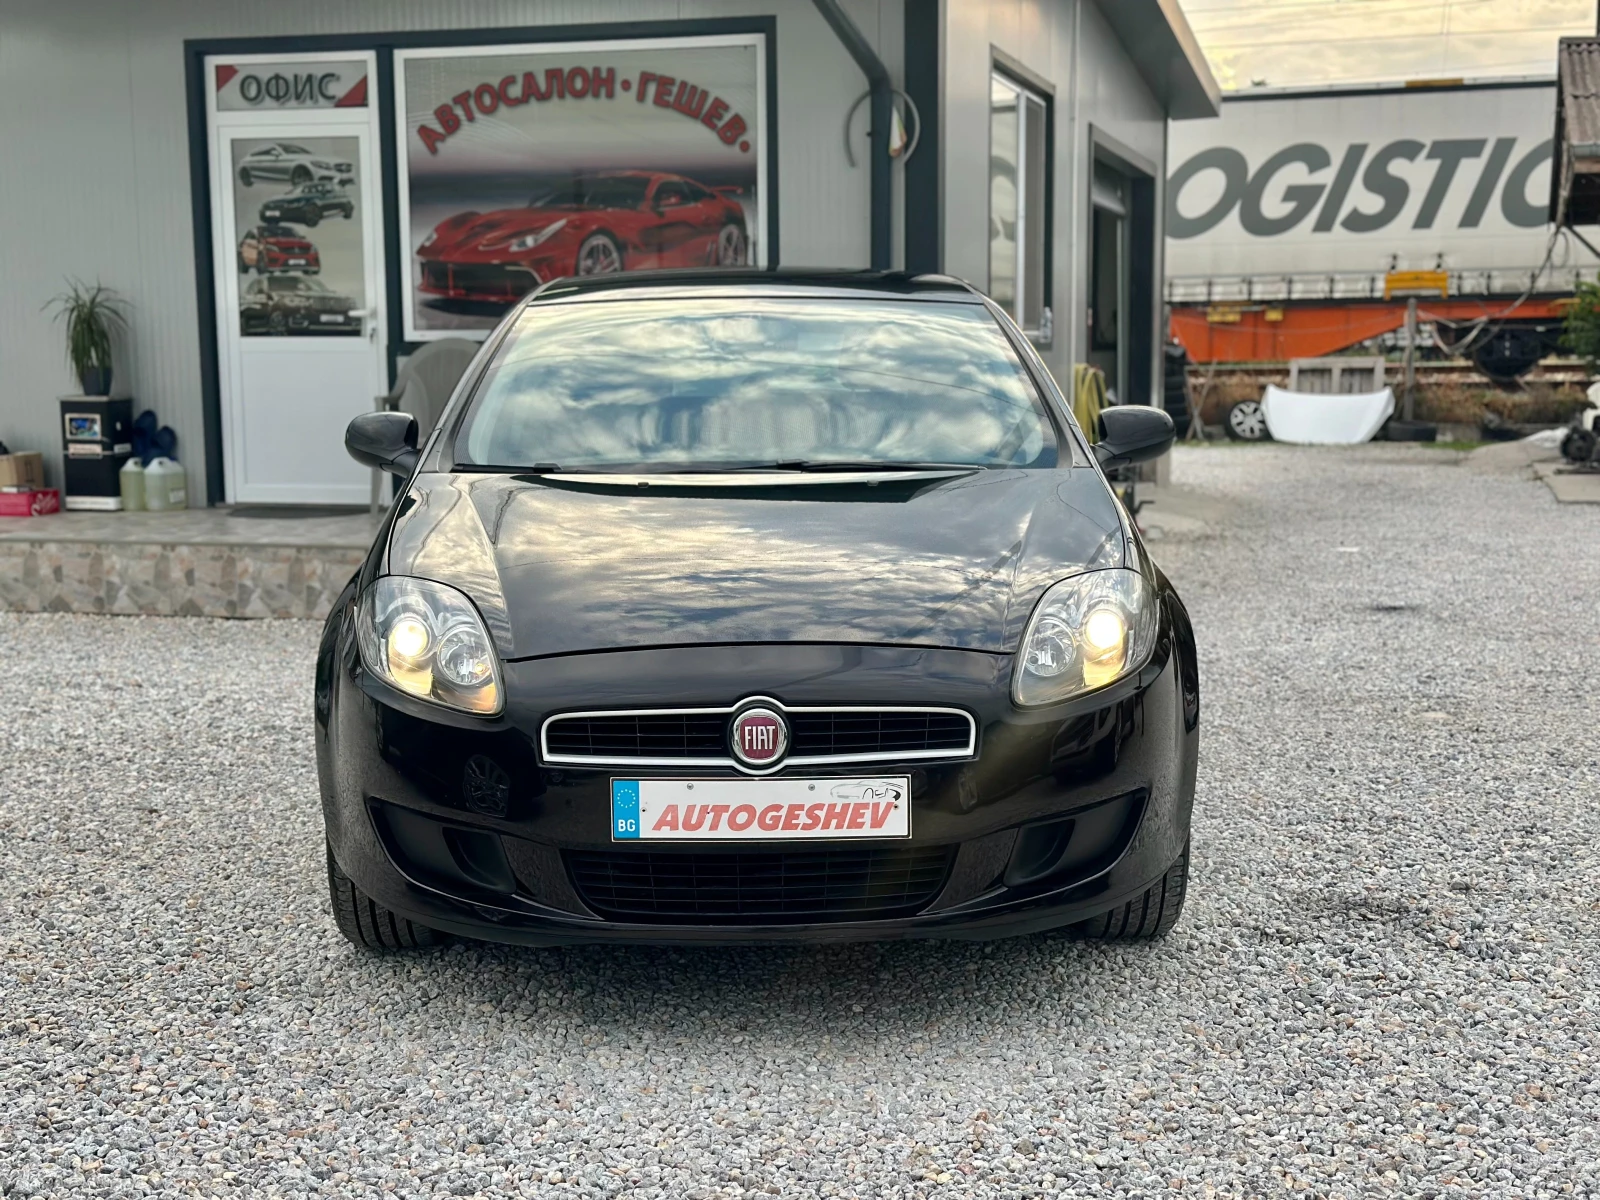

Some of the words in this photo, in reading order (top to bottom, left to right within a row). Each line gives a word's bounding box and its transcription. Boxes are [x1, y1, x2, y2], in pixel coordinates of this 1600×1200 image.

[239, 72, 341, 103] ОФИС
[416, 66, 615, 155] АВТОСАЛОН
[744, 725, 776, 750] FIAT
[618, 819, 636, 832] BG
[651, 801, 895, 832] AUTOGESHEV
